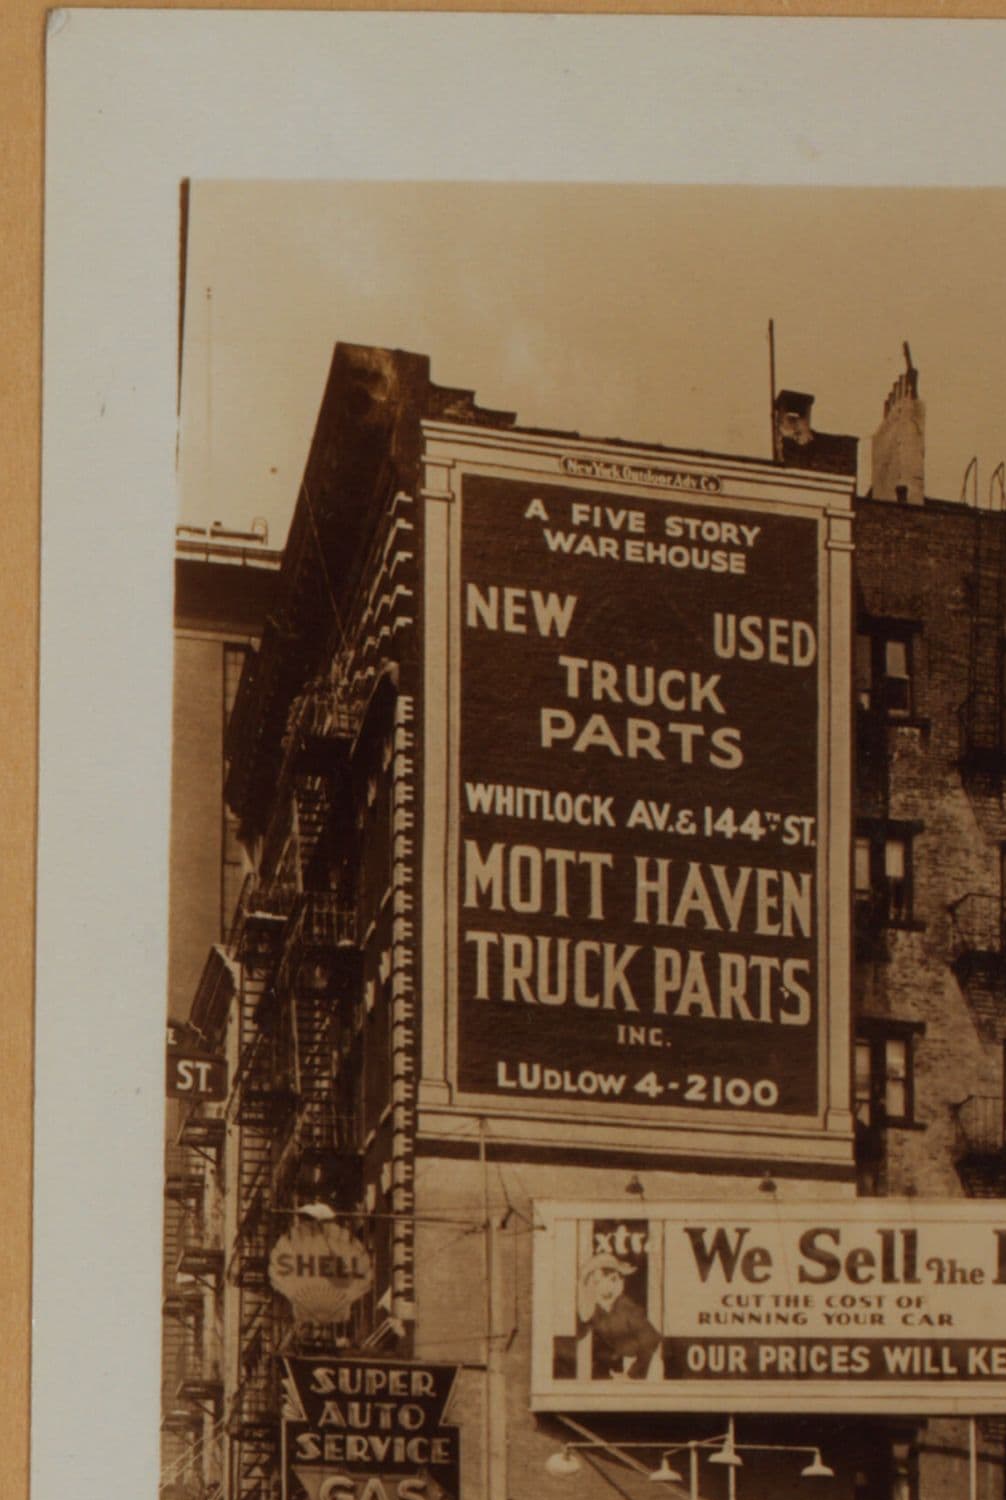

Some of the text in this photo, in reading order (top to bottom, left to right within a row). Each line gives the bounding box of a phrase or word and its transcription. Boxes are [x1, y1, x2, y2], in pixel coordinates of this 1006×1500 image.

[524, 499, 761, 548] A FIVE STORY
[543, 529, 746, 575] WAREHOUSE
[465, 583, 817, 668] NEW USED
[559, 655, 726, 714] TRUCK
[540, 708, 743, 770] PARTS
[464, 782, 615, 827] WHITLOCK
[781, 816, 817, 847] ST.
[463, 839, 812, 939] MOTT HAVEN
[465, 930, 811, 1026] TRUCK PARTS
[617, 1025, 672, 1047] INC.
[176, 1059, 213, 1093] ST.
[497, 1062, 627, 1095] LUDLOW
[276, 1256, 365, 1280] SHELL
[684, 1227, 773, 1283] We
[799, 1228, 920, 1285] Sell
[721, 1294, 927, 1308] CUT THE COST OF
[699, 1312, 954, 1326] RUNNING YOUR CAR
[687, 1345, 748, 1372] OUR
[758, 1346, 871, 1373] PRICES
[884, 1347, 958, 1374] WILL
[310, 1367, 437, 1397] SUPER
[318, 1401, 426, 1430] AUTO
[296, 1433, 450, 1464] SERVICE
